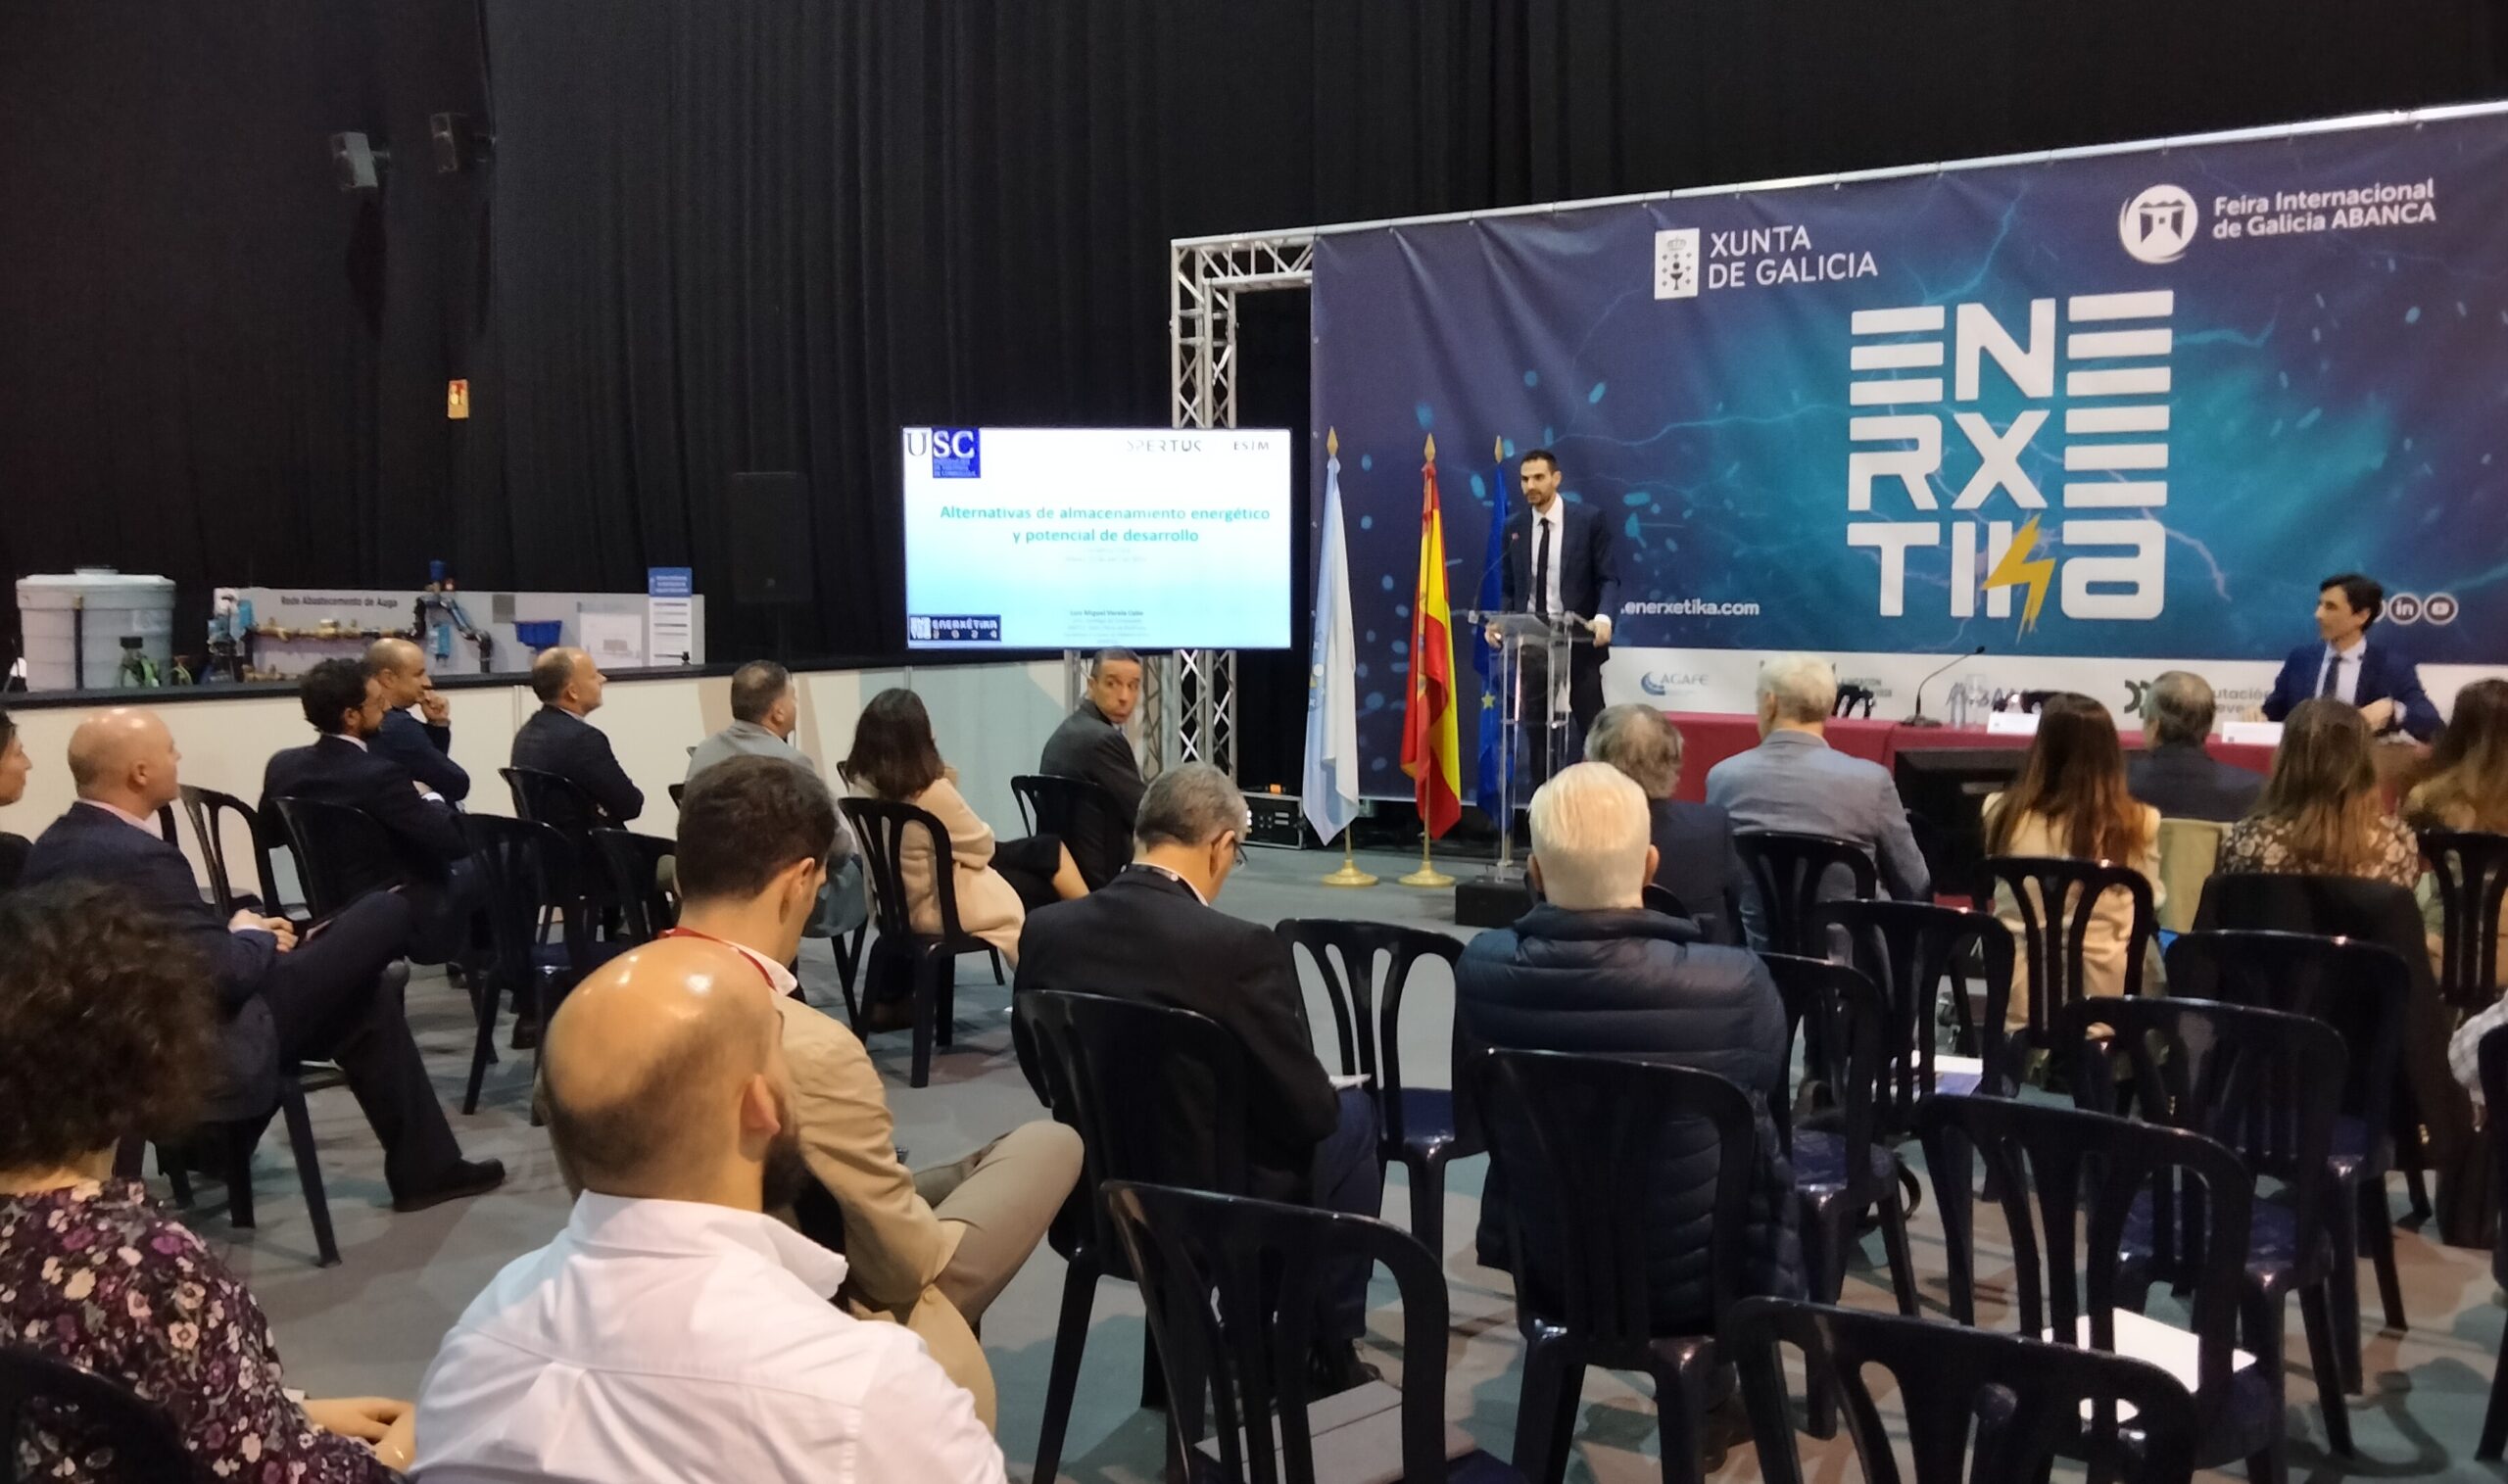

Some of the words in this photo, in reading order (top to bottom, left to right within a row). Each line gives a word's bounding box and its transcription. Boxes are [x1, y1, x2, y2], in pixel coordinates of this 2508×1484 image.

[2213, 194, 2269, 217] Feira
[2275, 176, 2435, 213] Internacional
[2212, 217, 2243, 239] de
[2246, 212, 2327, 237] Galicia
[2331, 201, 2436, 230] ABANCA
[1709, 224, 1812, 259] XUNTA
[1708, 261, 1747, 290] DE
[1755, 251, 1879, 286] GALICIA
[940, 505, 1032, 520] Alternativas
[1037, 505, 1054, 520] de
[1059, 505, 1186, 520] almacenamiento
[1190, 505, 1271, 522] energético
[1013, 532, 1021, 544] y
[1026, 528, 1095, 544] potencial
[1099, 528, 1118, 543] de
[1123, 528, 1199, 543] desarrollo
